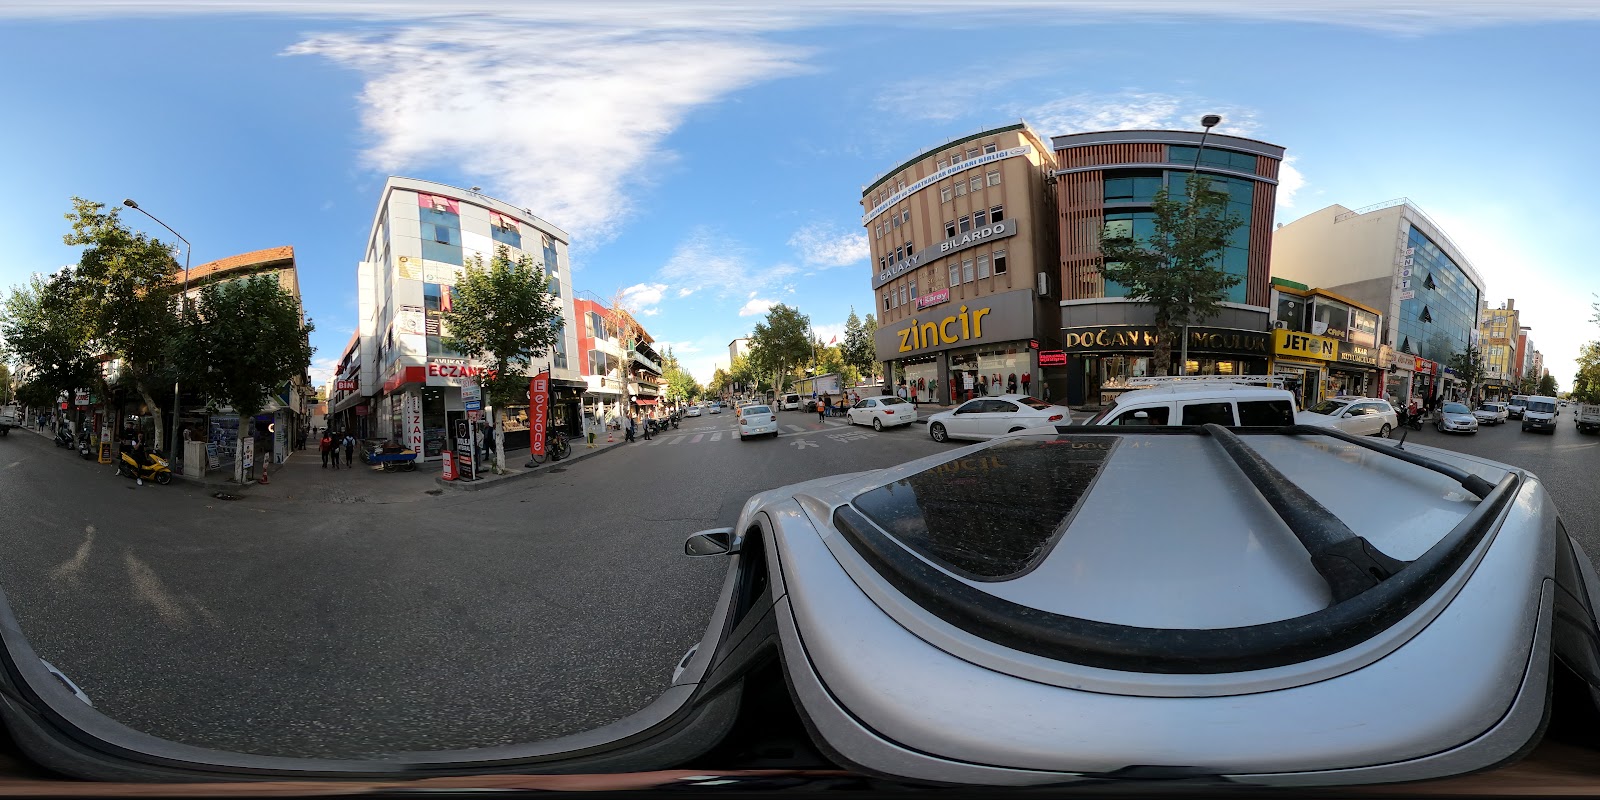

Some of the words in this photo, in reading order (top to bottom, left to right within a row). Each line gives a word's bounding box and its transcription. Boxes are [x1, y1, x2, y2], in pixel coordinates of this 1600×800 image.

[880, 255, 919, 281] GALAXY
[897, 305, 991, 353] zincir
[1066, 329, 1140, 348] DOĞAN
[1283, 334, 1333, 355] JETON
[534, 394, 544, 451] eczane
